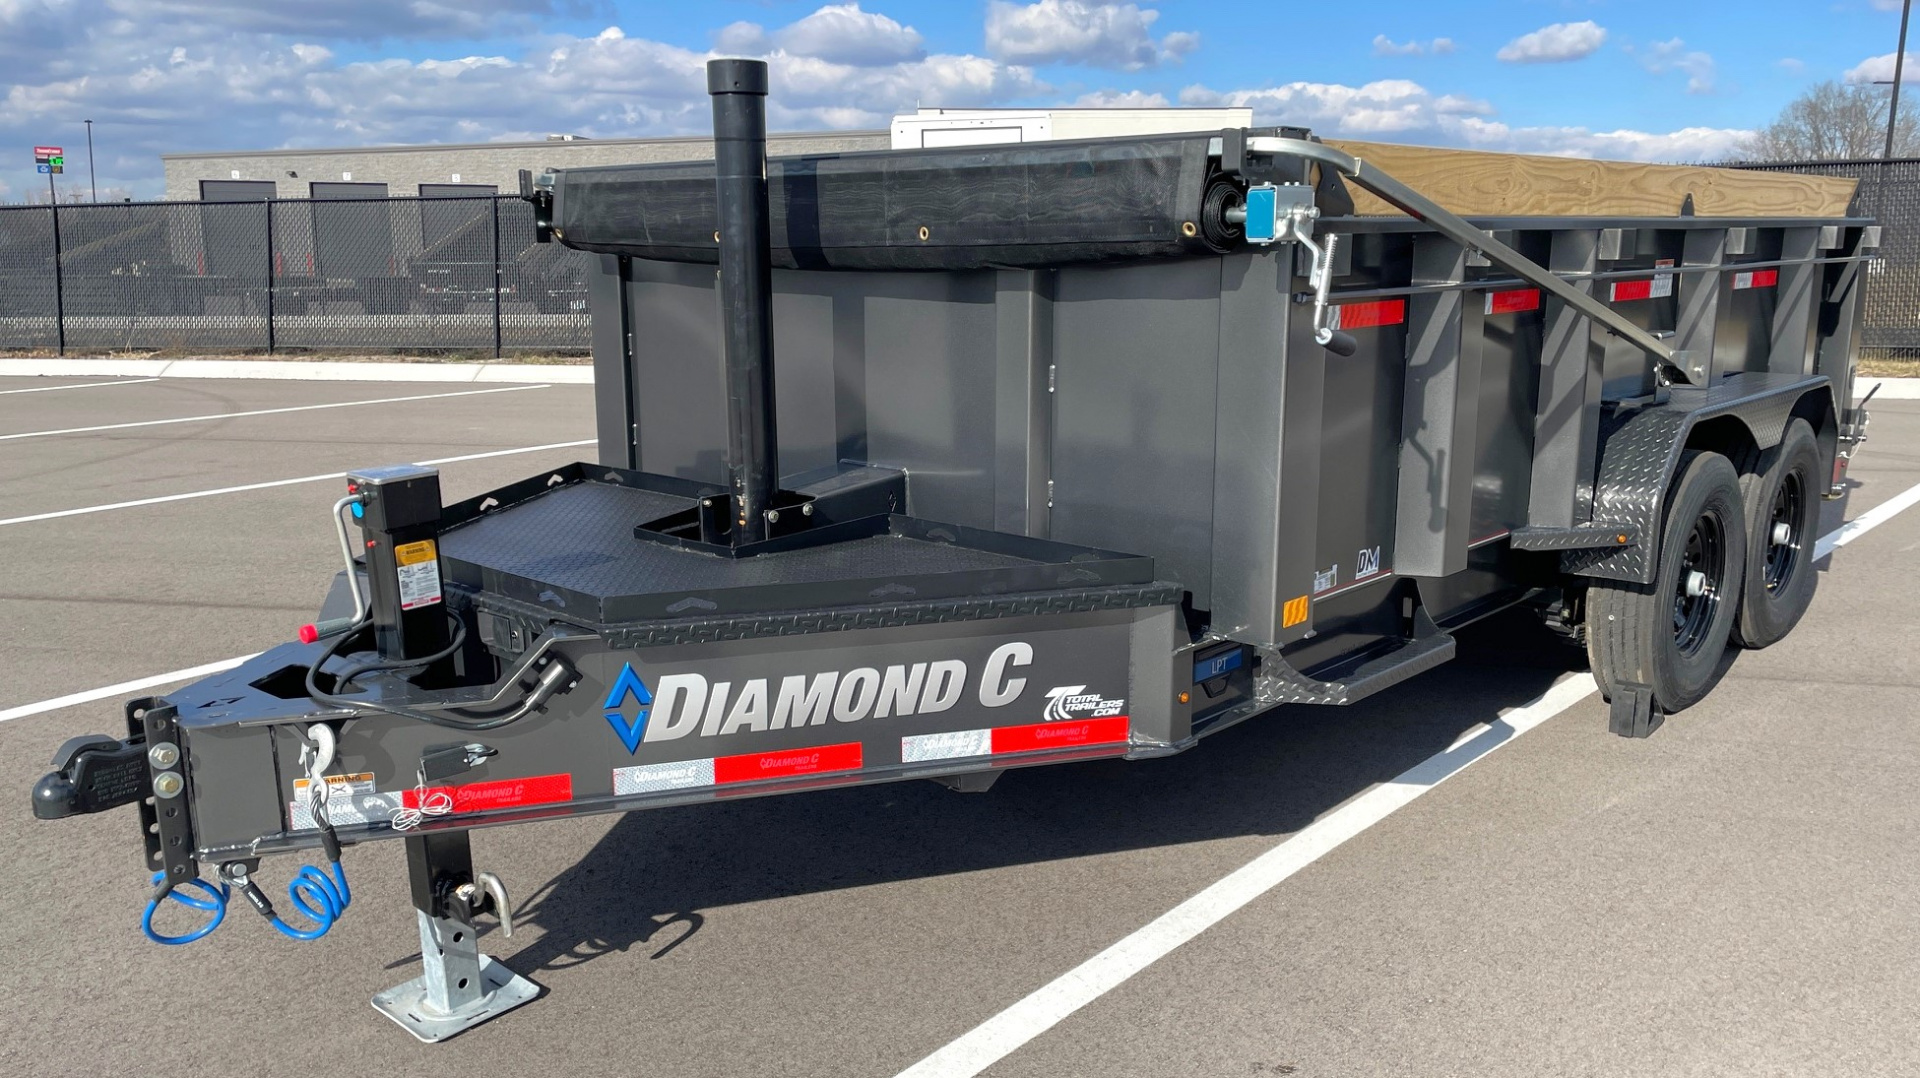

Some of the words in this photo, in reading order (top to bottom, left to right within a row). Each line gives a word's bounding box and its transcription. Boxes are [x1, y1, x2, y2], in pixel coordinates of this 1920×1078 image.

[1357, 547, 1379, 574] DM
[1211, 657, 1228, 674] LPT
[643, 659, 967, 742] DIAMOND
[978, 642, 1034, 707] C
[1066, 694, 1103, 704] TOTAL
[1065, 699, 1124, 712] TRAILERS
[1091, 707, 1121, 717] .COM
[1041, 727, 1080, 738] DIAMOND
[1081, 724, 1090, 735] C
[766, 755, 809, 767] DIAMOND
[810, 752, 820, 764] C
[323, 775, 362, 784] ARNING
[639, 769, 687, 781] DIAMOND
[687, 766, 697, 776] C
[463, 787, 513, 801] DIAMOND
[514, 784, 524, 796] C
